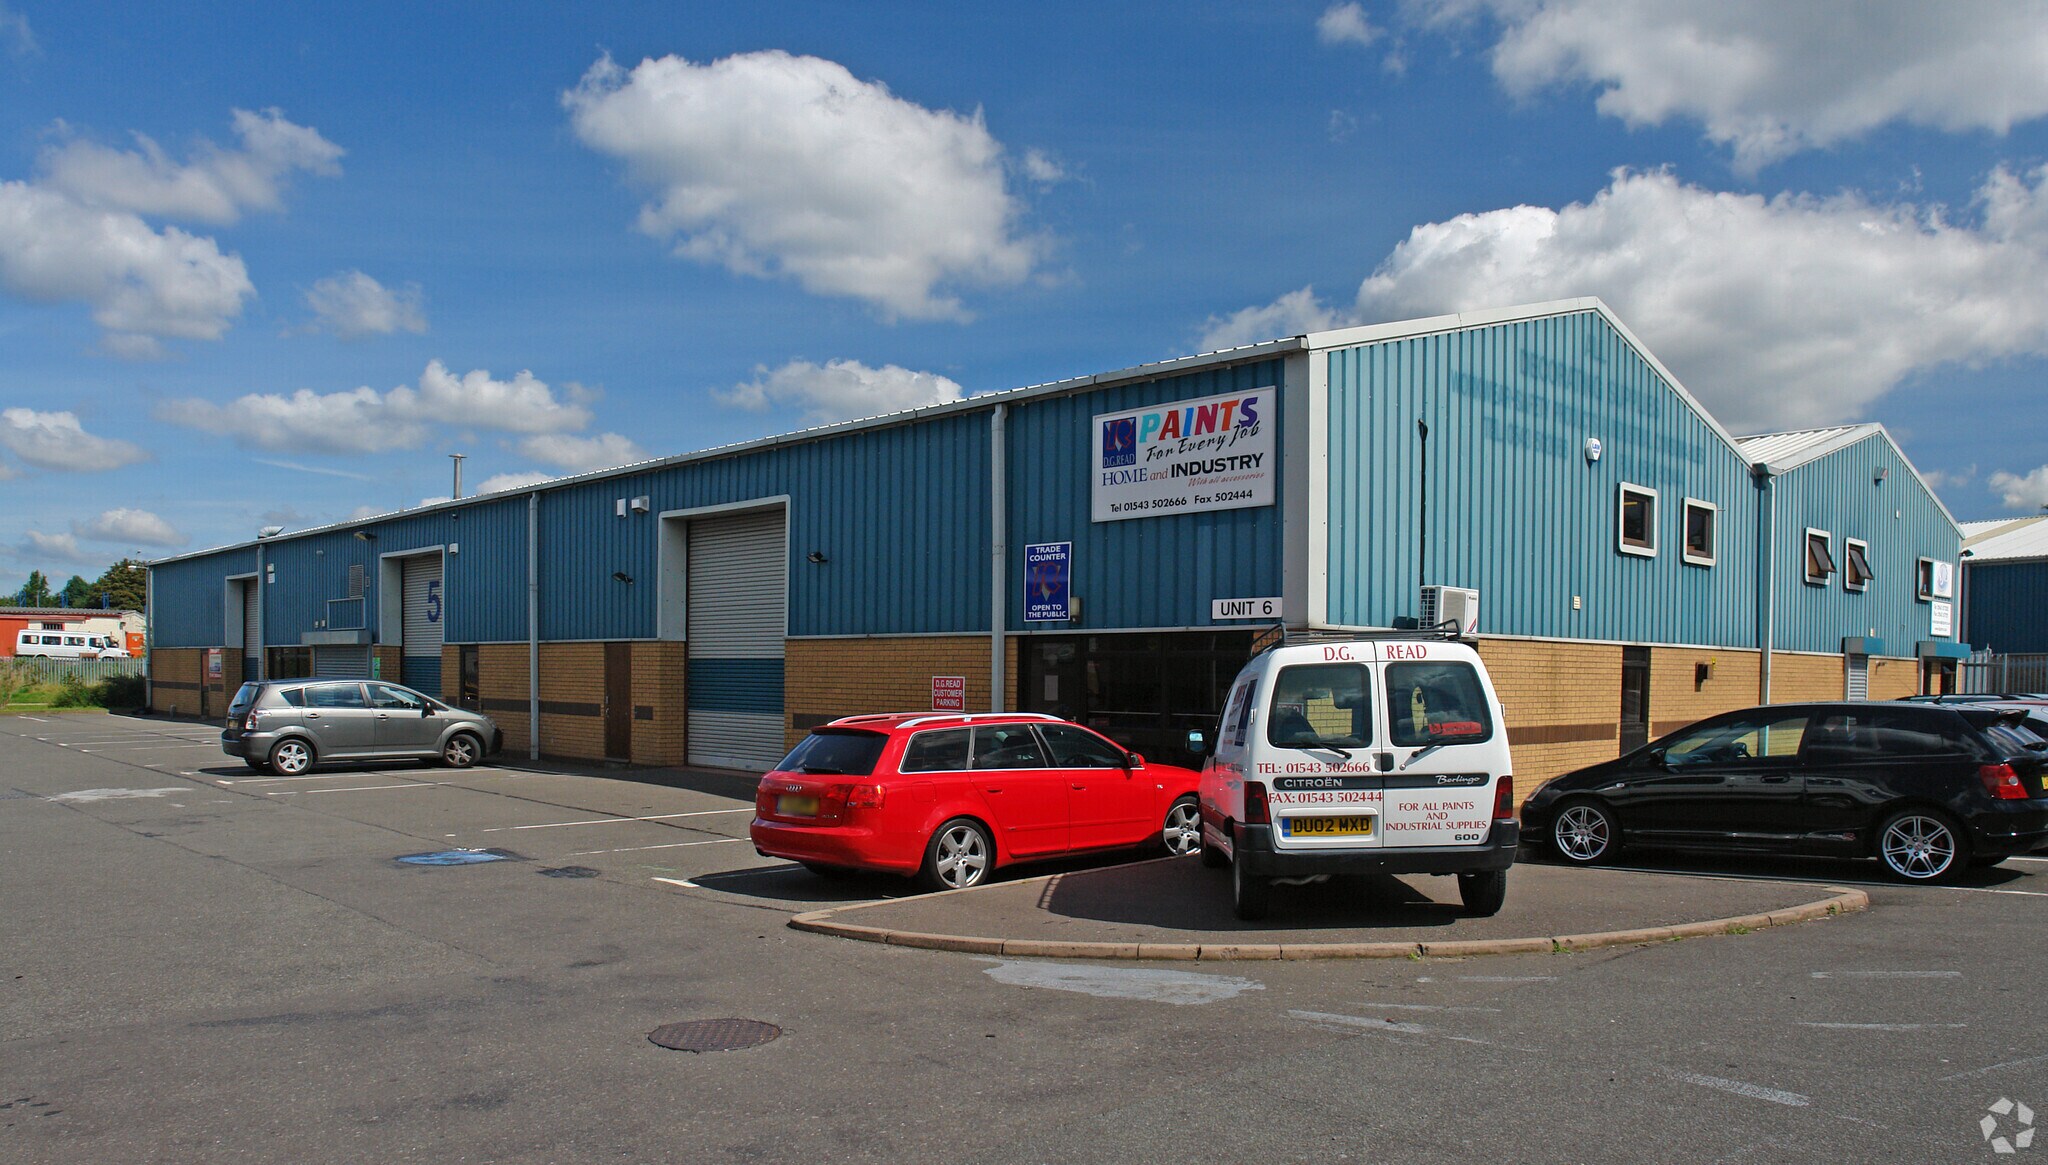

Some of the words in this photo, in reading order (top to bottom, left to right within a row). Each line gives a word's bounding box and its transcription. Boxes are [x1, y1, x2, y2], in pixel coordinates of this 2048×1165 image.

[1139, 397, 1259, 443] PAINTS
[1146, 445, 1175, 462] For
[1178, 434, 1229, 454] Every
[1229, 420, 1263, 447] Job
[1103, 453, 1135, 468] D.G.READ
[1102, 467, 1148, 486] HOME
[1150, 468, 1169, 481] and
[1171, 453, 1264, 478] INDUSTRY
[1188, 476, 1207, 487] With
[1208, 476, 1220, 485] all
[1221, 472, 1265, 483] accessories
[1111, 503, 1122, 513] Tel
[1124, 501, 1149, 511] 01543
[1152, 496, 1187, 509] 502666
[1194, 494, 1212, 504] Fax
[1215, 489, 1253, 501] 502444
[1036, 546, 1061, 554] TRADE
[1029, 553, 1066, 562] COUNTER
[427, 580, 441, 622] 5
[1042, 610, 1066, 618] PUBLIC
[1221, 601, 1255, 616] UNIT
[1262, 600, 1273, 615] 6
[1323, 647, 1354, 661] D.G.
[1387, 645, 1427, 659] READ
[934, 689, 963, 697] CUSTOMER
[936, 698, 960, 707] PARKING
[1257, 763, 1282, 774] TEL:
[1286, 762, 1322, 774] 01543
[1325, 762, 1370, 773] 502666
[1284, 777, 1342, 787] CITROËN
[1435, 774, 1481, 785] Berlingo
[1268, 792, 1295, 804] FAX:
[1298, 792, 1333, 804] 01543
[1337, 791, 1383, 803] 502444
[1399, 802, 1419, 811] FOR
[1422, 802, 1439, 811] ALL
[1442, 801, 1474, 810] PAINTS
[1426, 812, 1448, 820] AND
[1294, 818, 1335, 833] DU02
[1339, 817, 1370, 832] MXD
[1385, 822, 1442, 831] INDUSTRIAL
[1446, 820, 1487, 830] SUPPLIES
